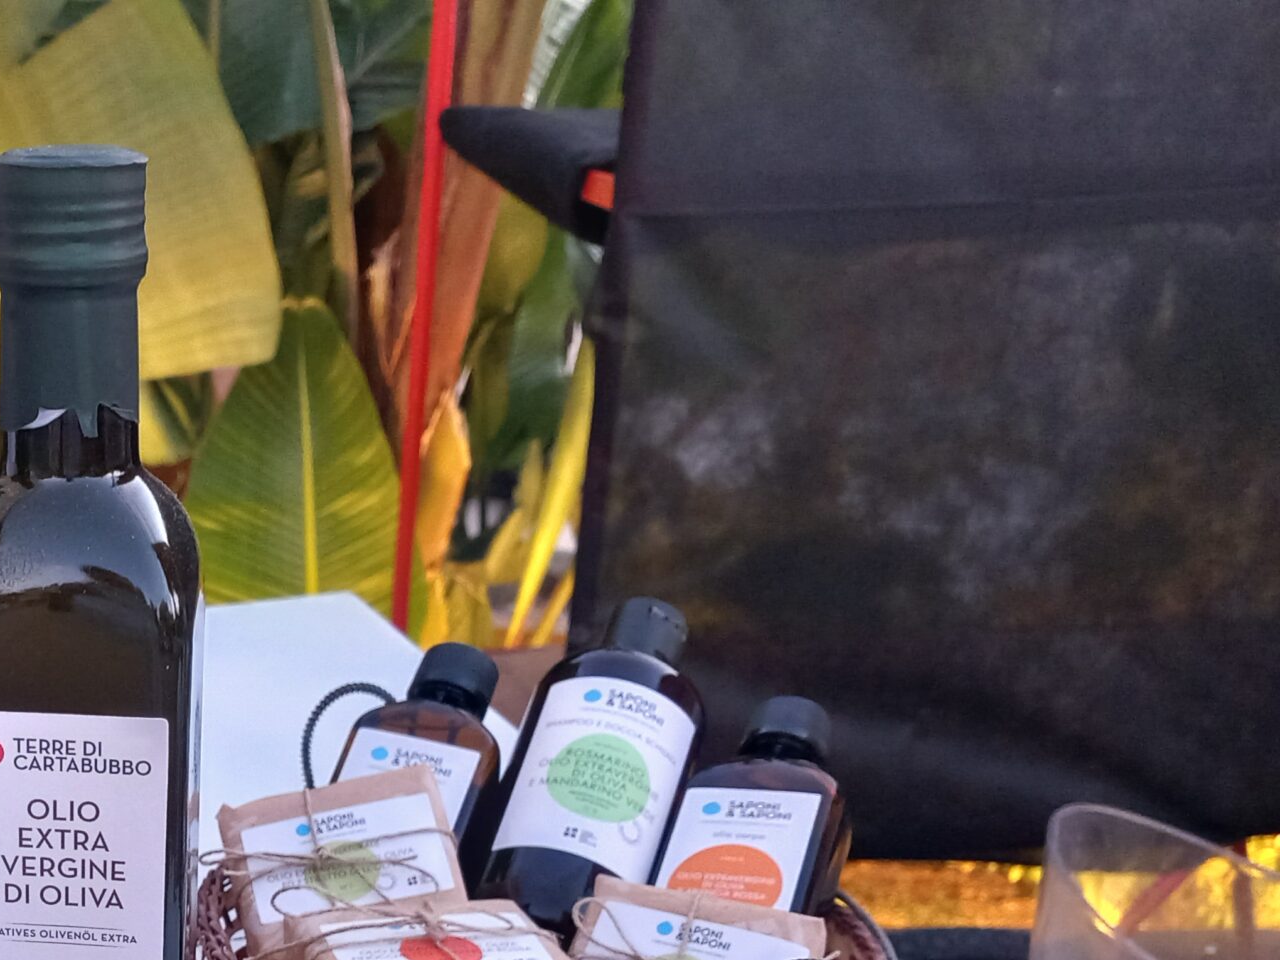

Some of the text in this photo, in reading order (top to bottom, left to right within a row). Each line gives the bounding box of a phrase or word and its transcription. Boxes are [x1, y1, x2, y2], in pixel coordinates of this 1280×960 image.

[609, 689, 657, 711] SAPONI
[618, 698, 665, 727] SAPONI
[13, 737, 102, 757] TERRE DI
[395, 748, 444, 764] SAPONI
[13, 754, 152, 776] CARTABUBBO
[27, 798, 100, 823] OLIO
[729, 800, 782, 810] SAPONI
[740, 810, 792, 821] SAPONI
[326, 817, 366, 833] SAPONI
[18, 827, 110, 852] EXTRA
[1, 854, 126, 882] VERGINE
[4, 883, 124, 910] DI OLIVA
[39, 929, 98, 942] OLIVENÖL
[101, 933, 137, 944] EXTRA
[687, 935, 731, 951] SAPONI
